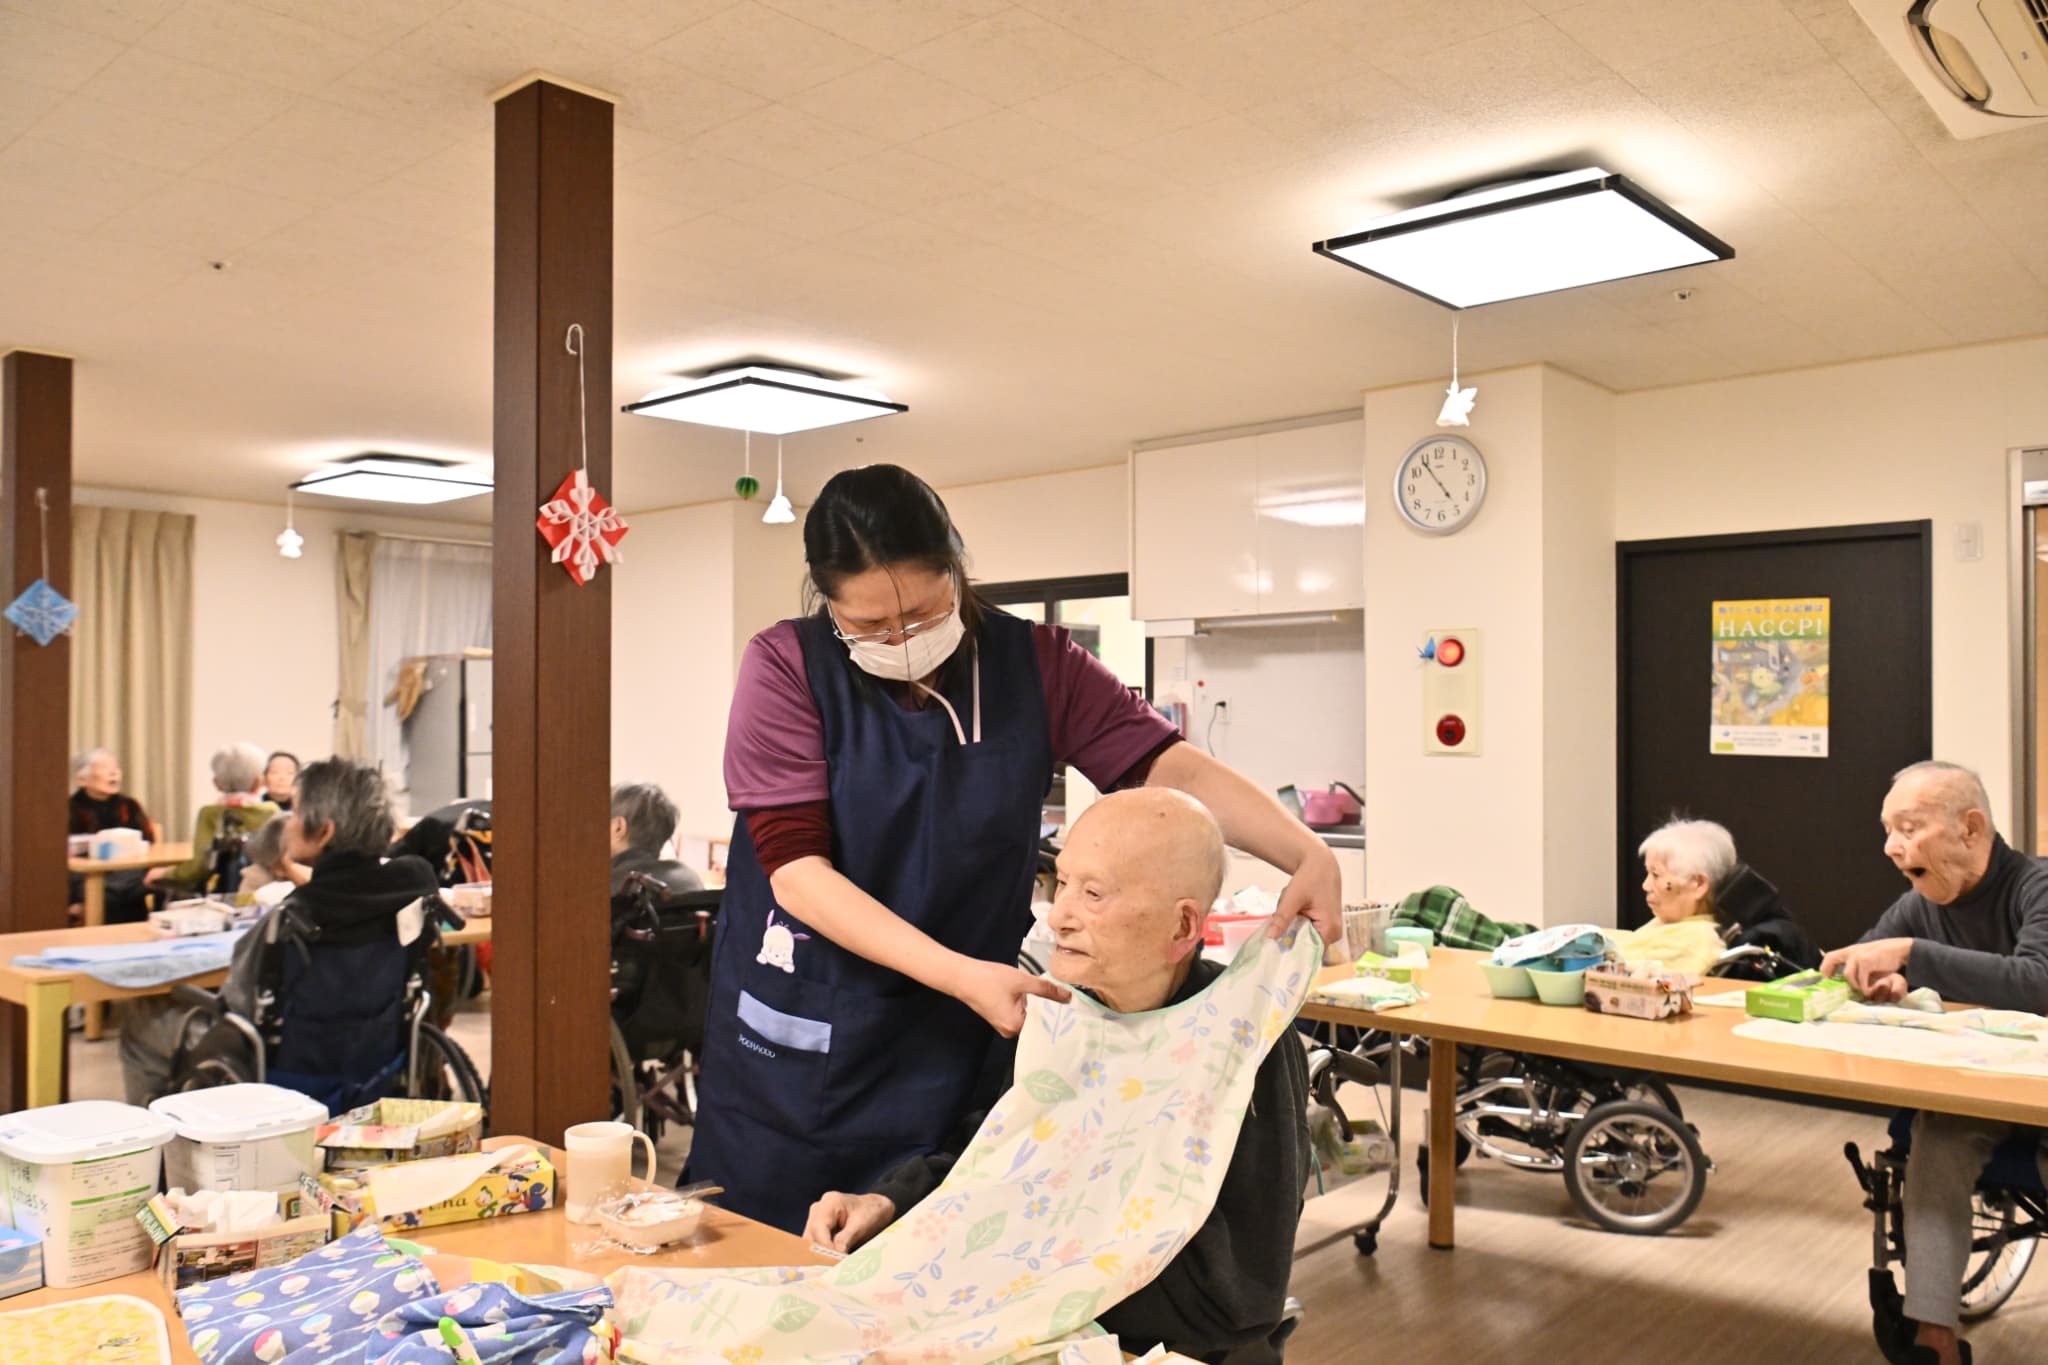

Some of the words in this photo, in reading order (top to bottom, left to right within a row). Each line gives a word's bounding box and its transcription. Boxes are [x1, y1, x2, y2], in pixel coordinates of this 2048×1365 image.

[1434, 446, 1445, 460] 12
[1461, 458, 1469, 471] 2
[1411, 467, 1422, 479] 10
[1467, 473, 1475, 486] 3
[1408, 484, 1416, 496] 9
[1413, 498, 1422, 510] 8
[1424, 509, 1431, 520] 7
[1437, 510, 1446, 521] 6
[1453, 505, 1461, 516] 5
